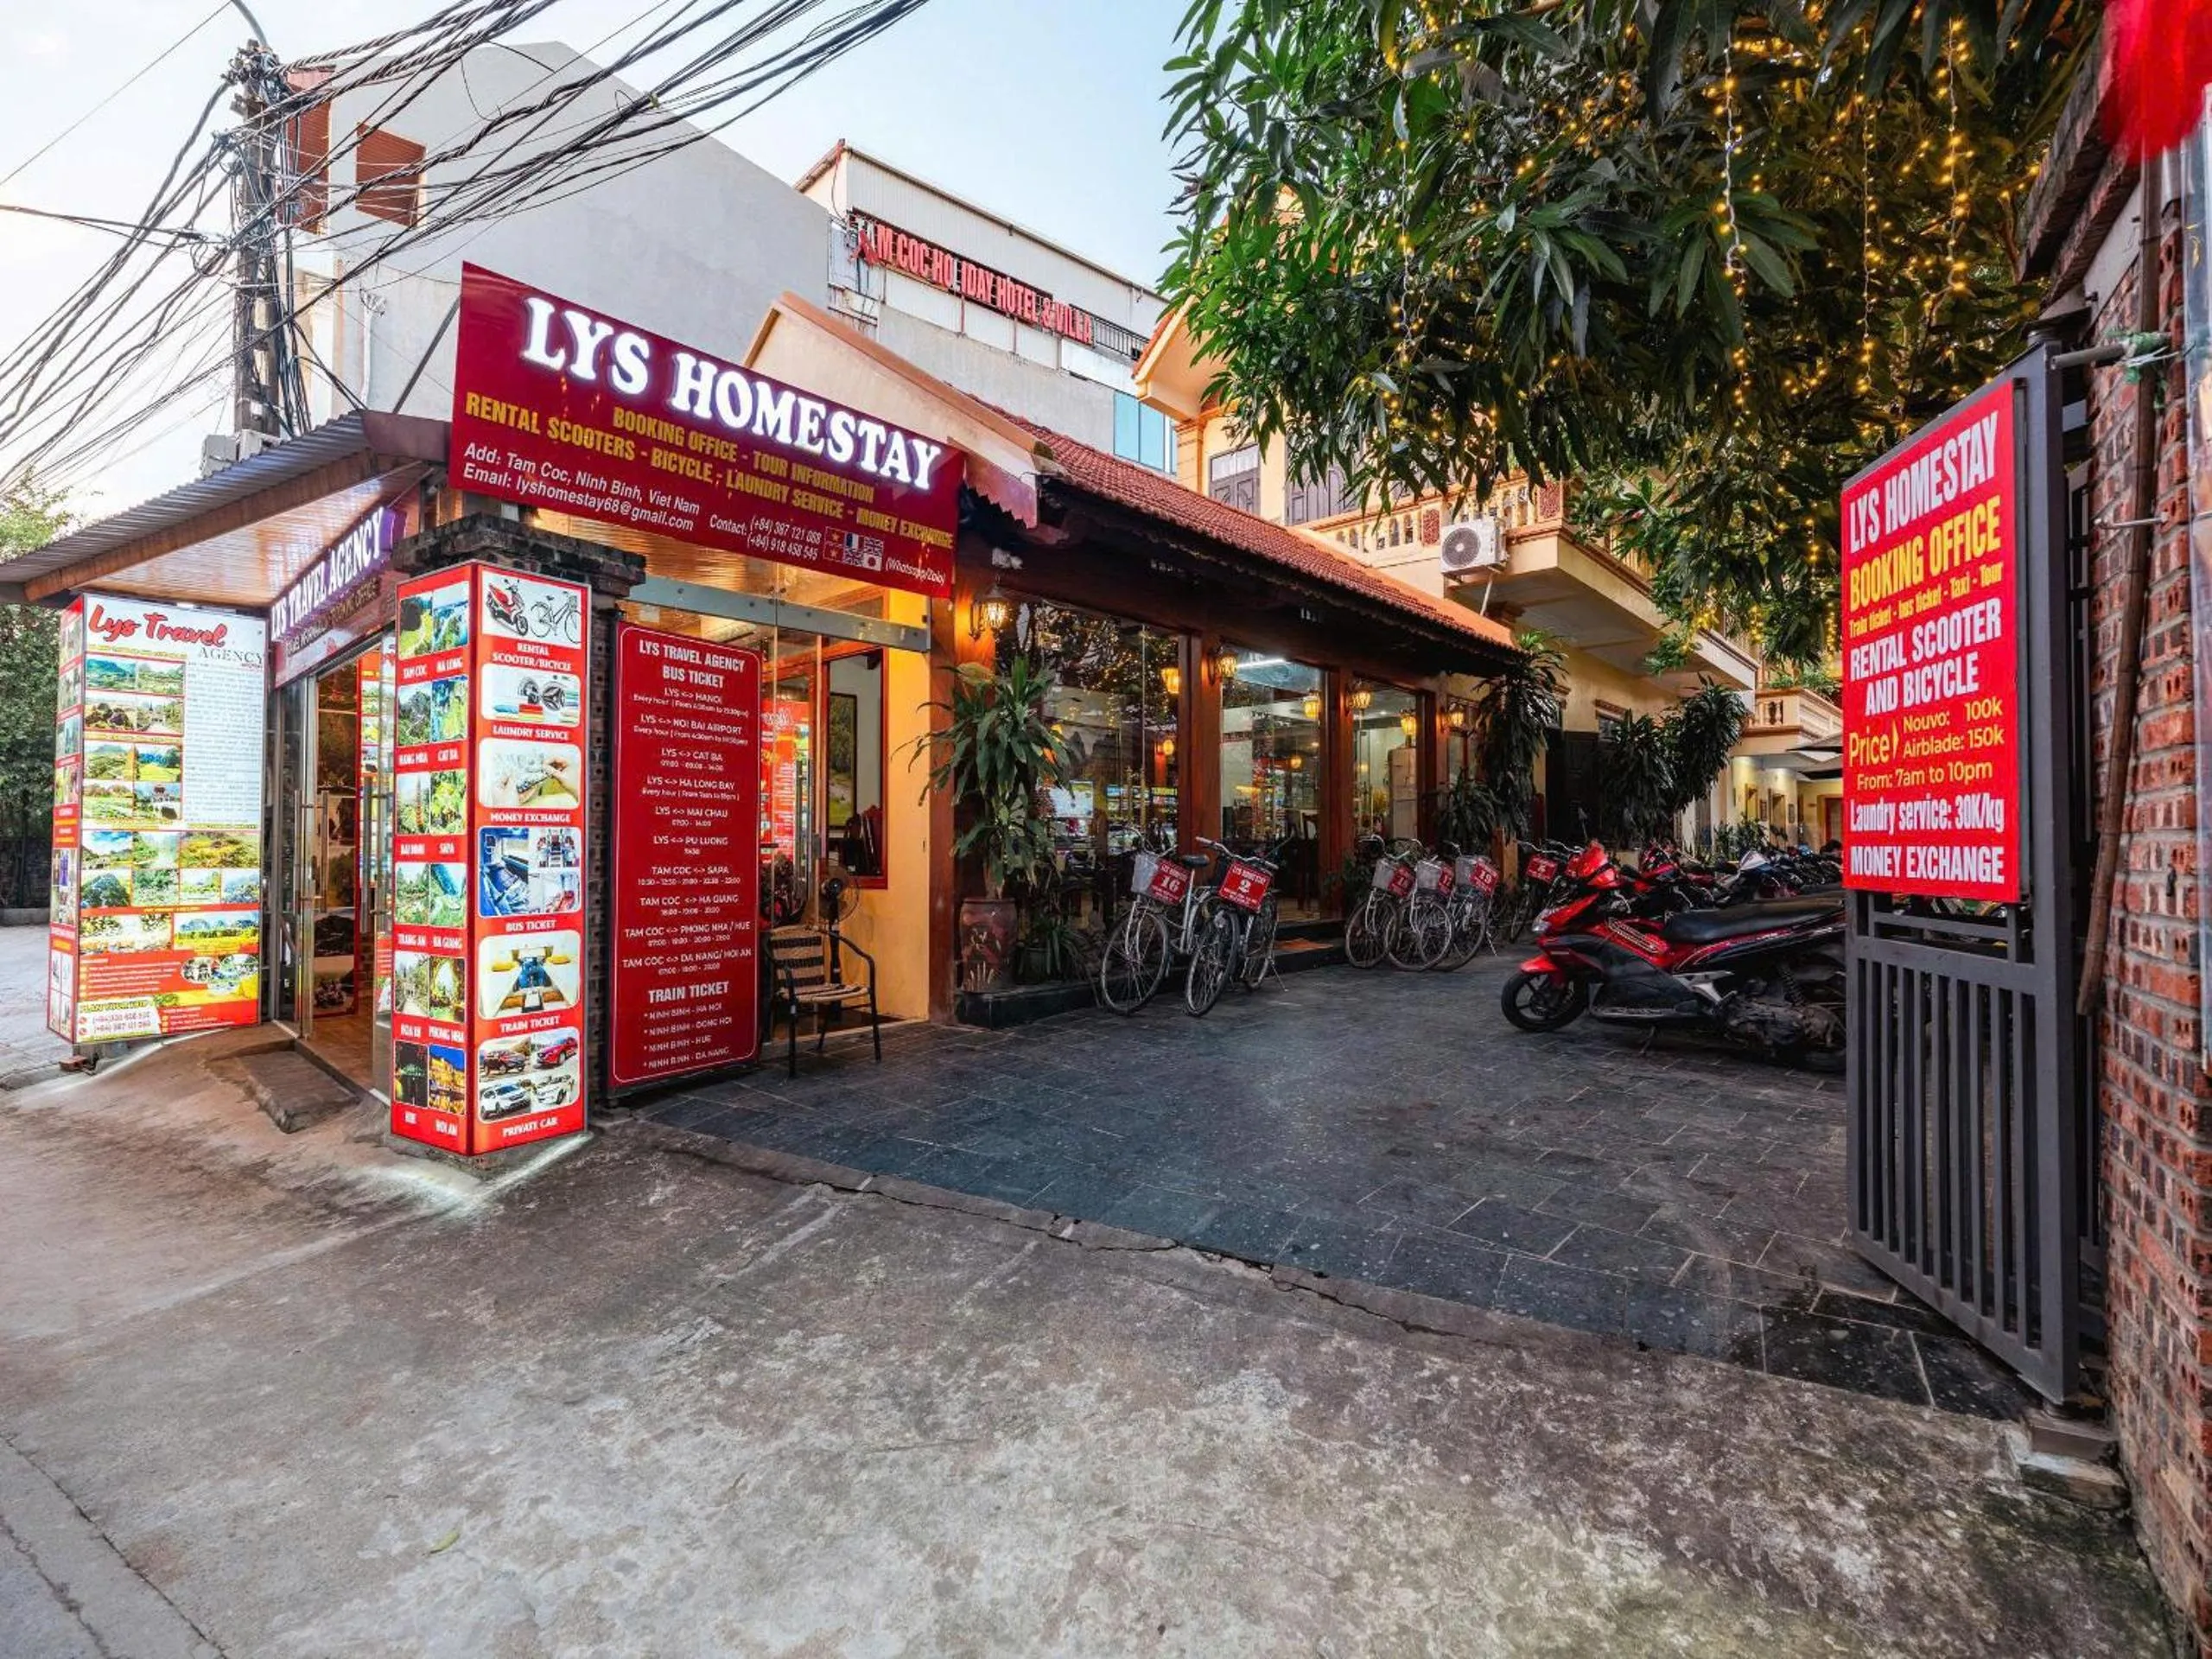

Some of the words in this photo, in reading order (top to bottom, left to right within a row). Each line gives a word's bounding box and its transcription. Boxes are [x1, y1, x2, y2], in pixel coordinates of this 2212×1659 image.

[897, 233, 929, 276] COC
[996, 276, 1039, 323] HOTEL
[1054, 300, 1093, 346] VILLA
[521, 296, 650, 395] LYS
[668, 351, 942, 490] HOMESTAY
[465, 391, 541, 435] RENTAL
[547, 416, 636, 461] SCOOTERS
[651, 447, 714, 484] BICYCLE
[726, 469, 789, 505] LAUNDRY
[792, 487, 843, 518] SERVICE
[613, 406, 684, 448] BOOKING
[688, 429, 738, 463] OFFICE
[753, 451, 787, 476] TOUR
[791, 462, 874, 504] INFORMATION
[464, 442, 501, 465] Add:
[507, 452, 536, 474] Tam
[540, 461, 571, 485] Coc,
[575, 471, 607, 492] Ninh
[611, 480, 643, 503] Binh,
[649, 489, 671, 509] Viet
[674, 498, 700, 517] Nam
[1849, 486, 1879, 555] LYS
[1885, 410, 1999, 536] HOMESTAY
[463, 462, 511, 488] Email:
[516, 475, 695, 533] lyshomestay68@gmail.com
[709, 514, 747, 536] Contact:
[1849, 534, 1924, 612] BOOKING
[1929, 494, 2001, 578] OFFICE
[271, 597, 288, 641] LYS
[289, 562, 327, 628] TRAVEL
[328, 506, 384, 594] AGENCY
[1950, 570, 1971, 600] Taxi
[1980, 561, 2004, 588] Tour
[89, 604, 141, 642] Lys
[143, 612, 227, 647] Travel
[518, 642, 550, 657] RENTAL
[1850, 632, 1907, 681] RENTAL
[1912, 597, 2001, 663] SCOOTER
[199, 647, 264, 664] AGENCY
[493, 652, 571, 671] SCOOTER/BICYCLE
[639, 639, 660, 657] LYS
[663, 645, 702, 664] TRAVEL
[704, 653, 745, 673] AGENCY
[663, 664, 685, 682] BUS
[689, 670, 725, 689] TICKET
[1865, 677, 1898, 716] AND
[1903, 651, 1980, 708] BICYCLE
[664, 687, 680, 697] LYS
[640, 714, 656, 724] LYS
[707, 723, 742, 735] AIRPORT
[1903, 710, 1950, 734] Nouvo:
[1964, 696, 2003, 722] 100k
[493, 725, 534, 738] LAUNDRY
[535, 728, 569, 741] SERVICE
[1903, 735, 1964, 759] Airblade:
[1968, 724, 2005, 747] 150k
[661, 747, 677, 758] LYS
[1849, 726, 1890, 767] Price
[647, 775, 663, 785] LYS
[694, 779, 717, 789] LONG
[719, 781, 735, 790] BAY
[1858, 773, 1892, 791] From:
[1896, 768, 1925, 787] 7am
[1929, 764, 1944, 783] to
[1947, 761, 1993, 786] 10pm
[490, 813, 524, 823] MONEY
[525, 813, 570, 823] EXCHANGE
[655, 806, 671, 815] LYS
[704, 809, 728, 818] CHAU
[1850, 797, 1895, 836] Laundry
[1898, 792, 1952, 832] service:
[1955, 792, 2005, 833] 30K/kg
[653, 836, 669, 844] LYS
[700, 837, 728, 846] LUONG
[652, 866, 671, 875] TAM
[672, 866, 691, 874] COC
[1850, 846, 1902, 878] MONEY
[1906, 846, 2005, 884] EXCHANGE
[1238, 879, 1251, 893] 2
[639, 897, 660, 906] TAM
[661, 896, 681, 905] COC
[505, 920, 524, 932] BUS
[526, 919, 556, 931] TICKET
[625, 928, 645, 938] TAM
[645, 927, 664, 936] COC
[681, 925, 710, 934] PHONG
[622, 958, 643, 969] TAM
[644, 957, 664, 966] COC
[648, 986, 686, 1003] TRAIN
[689, 981, 729, 997] TICKET
[500, 1020, 528, 1033] TRAIN
[530, 1015, 561, 1027] TICKET
[502, 1123, 538, 1138] PRIVATE
[539, 1116, 559, 1128] CAR
